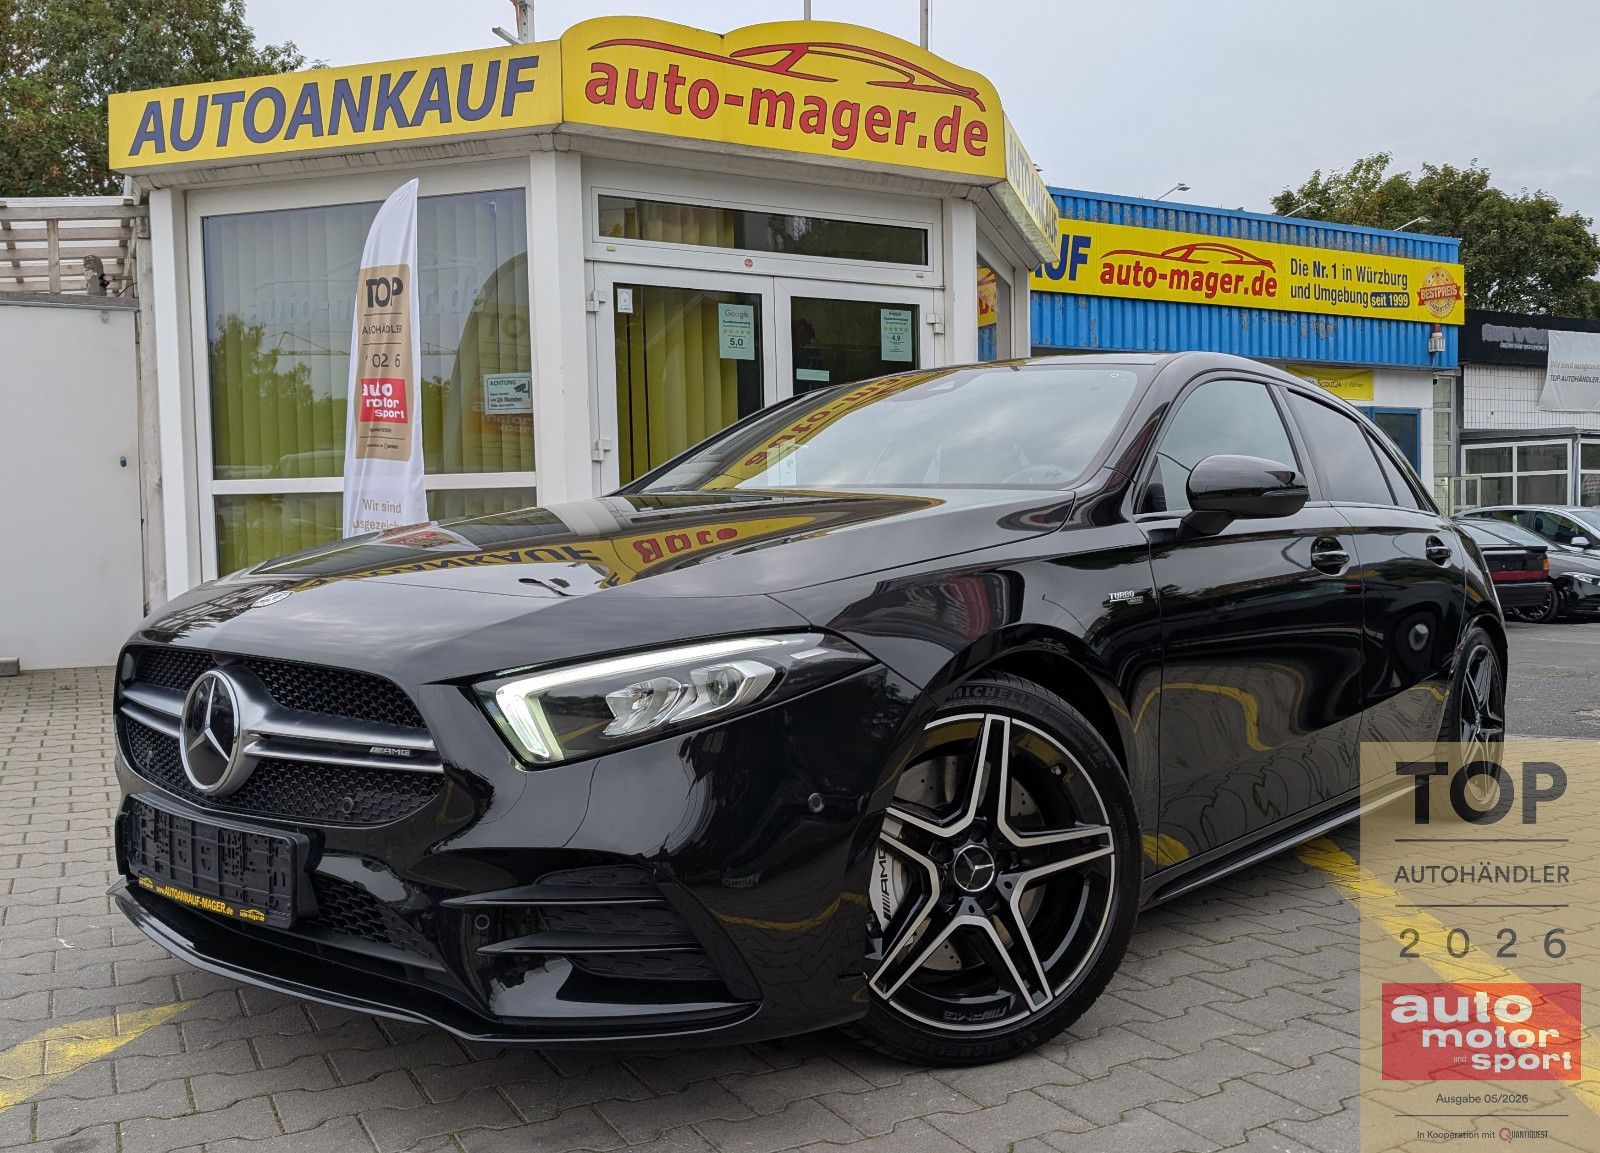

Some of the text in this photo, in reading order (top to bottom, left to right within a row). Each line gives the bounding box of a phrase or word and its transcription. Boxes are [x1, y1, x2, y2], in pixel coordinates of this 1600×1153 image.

[128, 55, 540, 156] AUTOANKAUF
[585, 61, 989, 156] auto-mager.de
[1100, 260, 1278, 298] auto-mager.de
[1290, 258, 1408, 290] Die Nr. 1 in Würzburg
[365, 276, 404, 308] TOP
[1290, 283, 1409, 308] und Umgebung seit 1999
[724, 310, 751, 319] Google
[729, 337, 744, 347] 5,0
[362, 498, 402, 514] Wir sind
